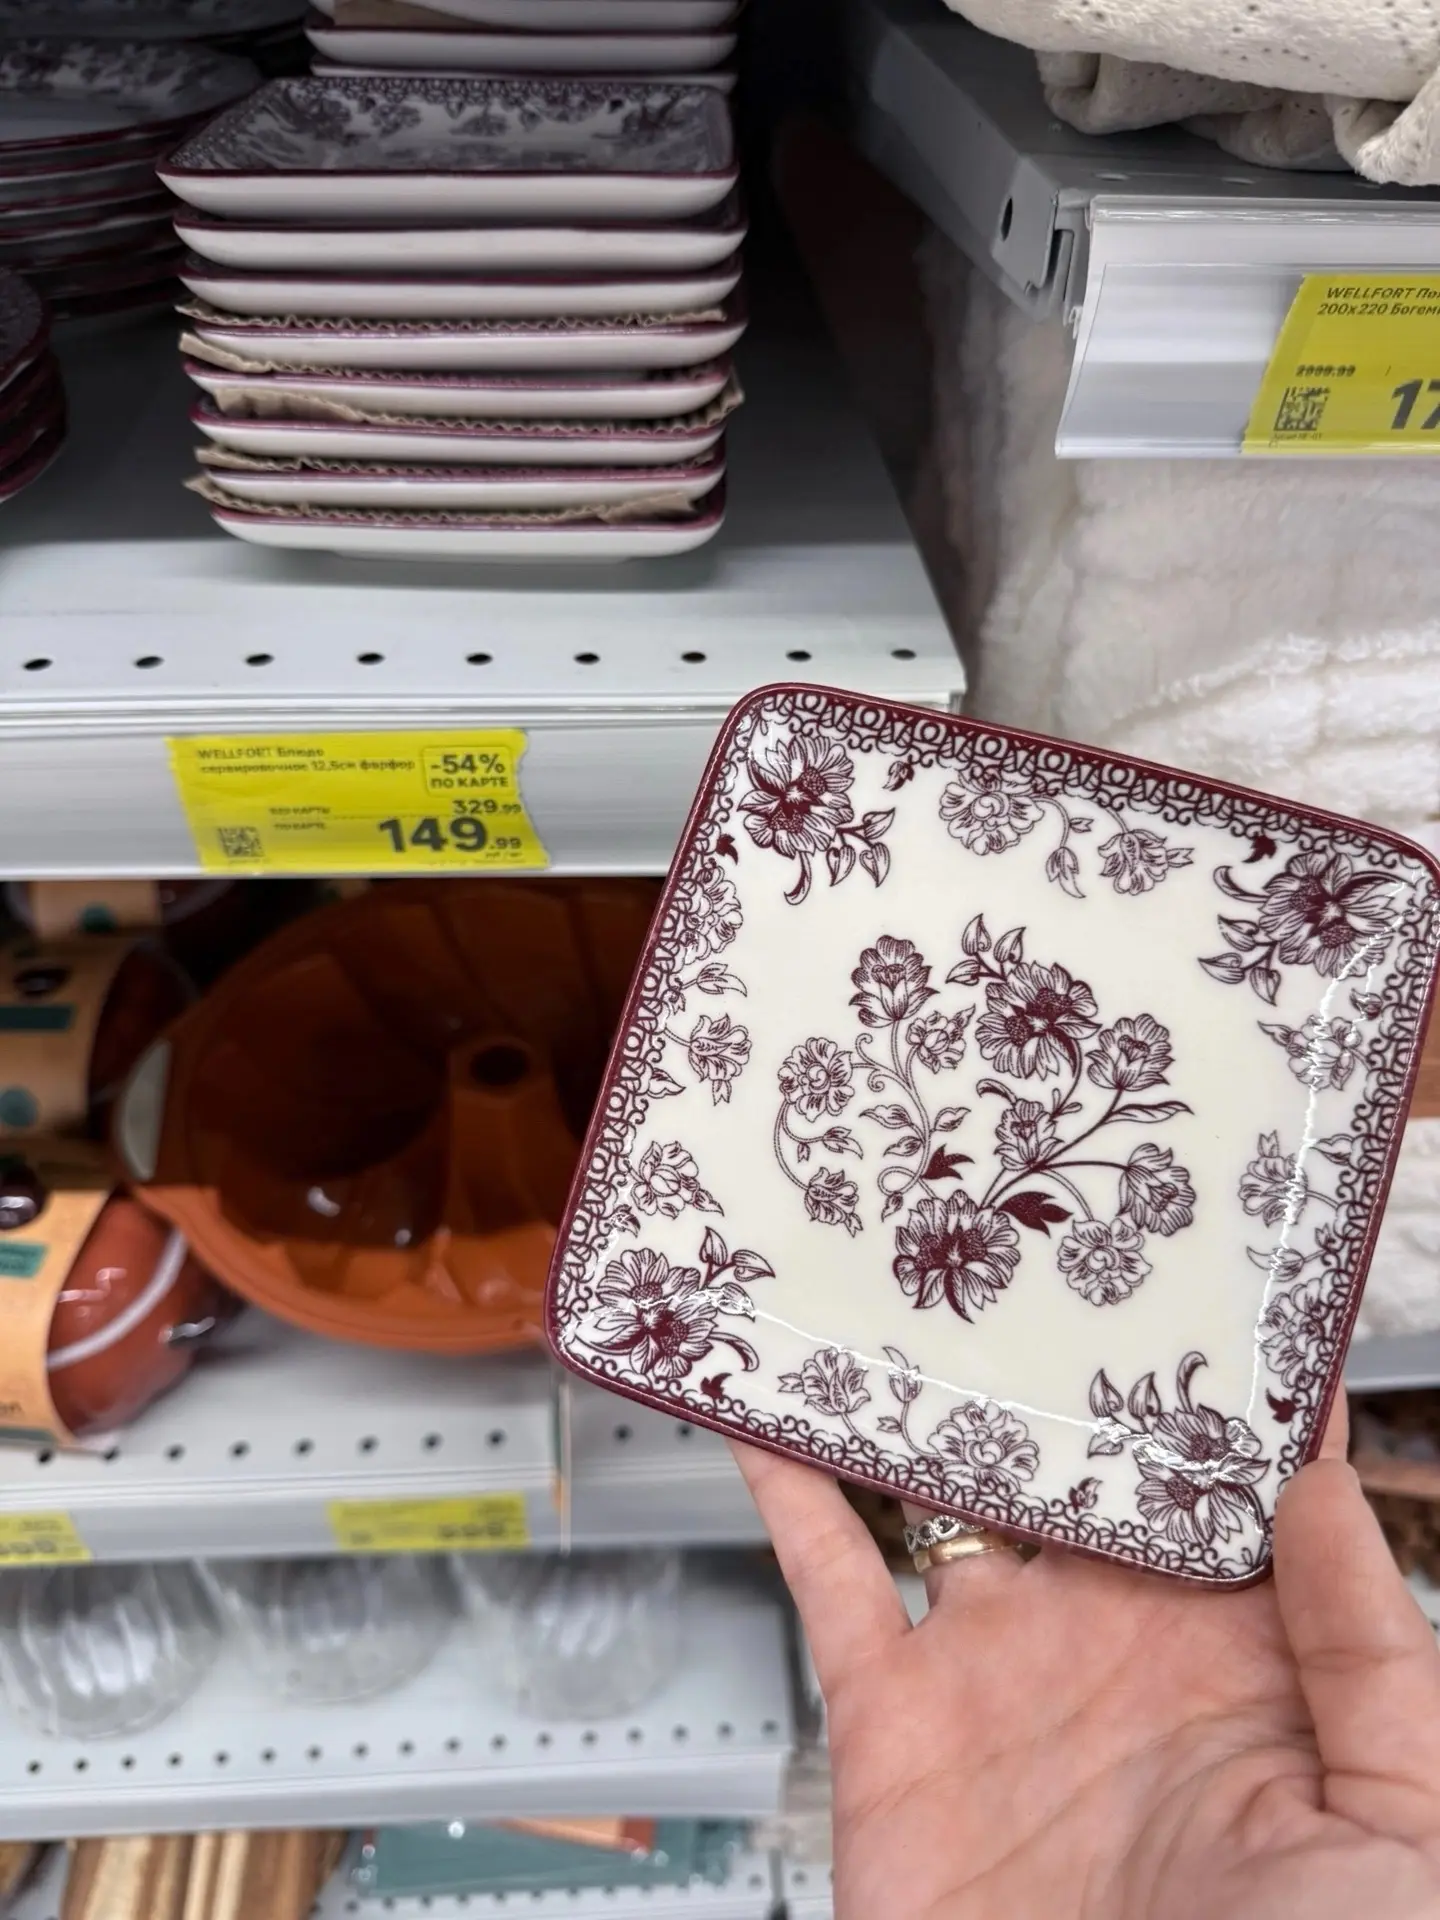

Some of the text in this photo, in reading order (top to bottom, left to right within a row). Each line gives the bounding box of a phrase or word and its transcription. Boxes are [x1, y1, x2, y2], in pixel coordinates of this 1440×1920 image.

[1327, 287, 1416, 300] WELLFORT
[198, 745, 325, 760] WELLFORT Блюдо
[359, 758, 416, 772] фарфор
[431, 753, 505, 774] -54%
[431, 777, 510, 789] ПО КАРТЕ
